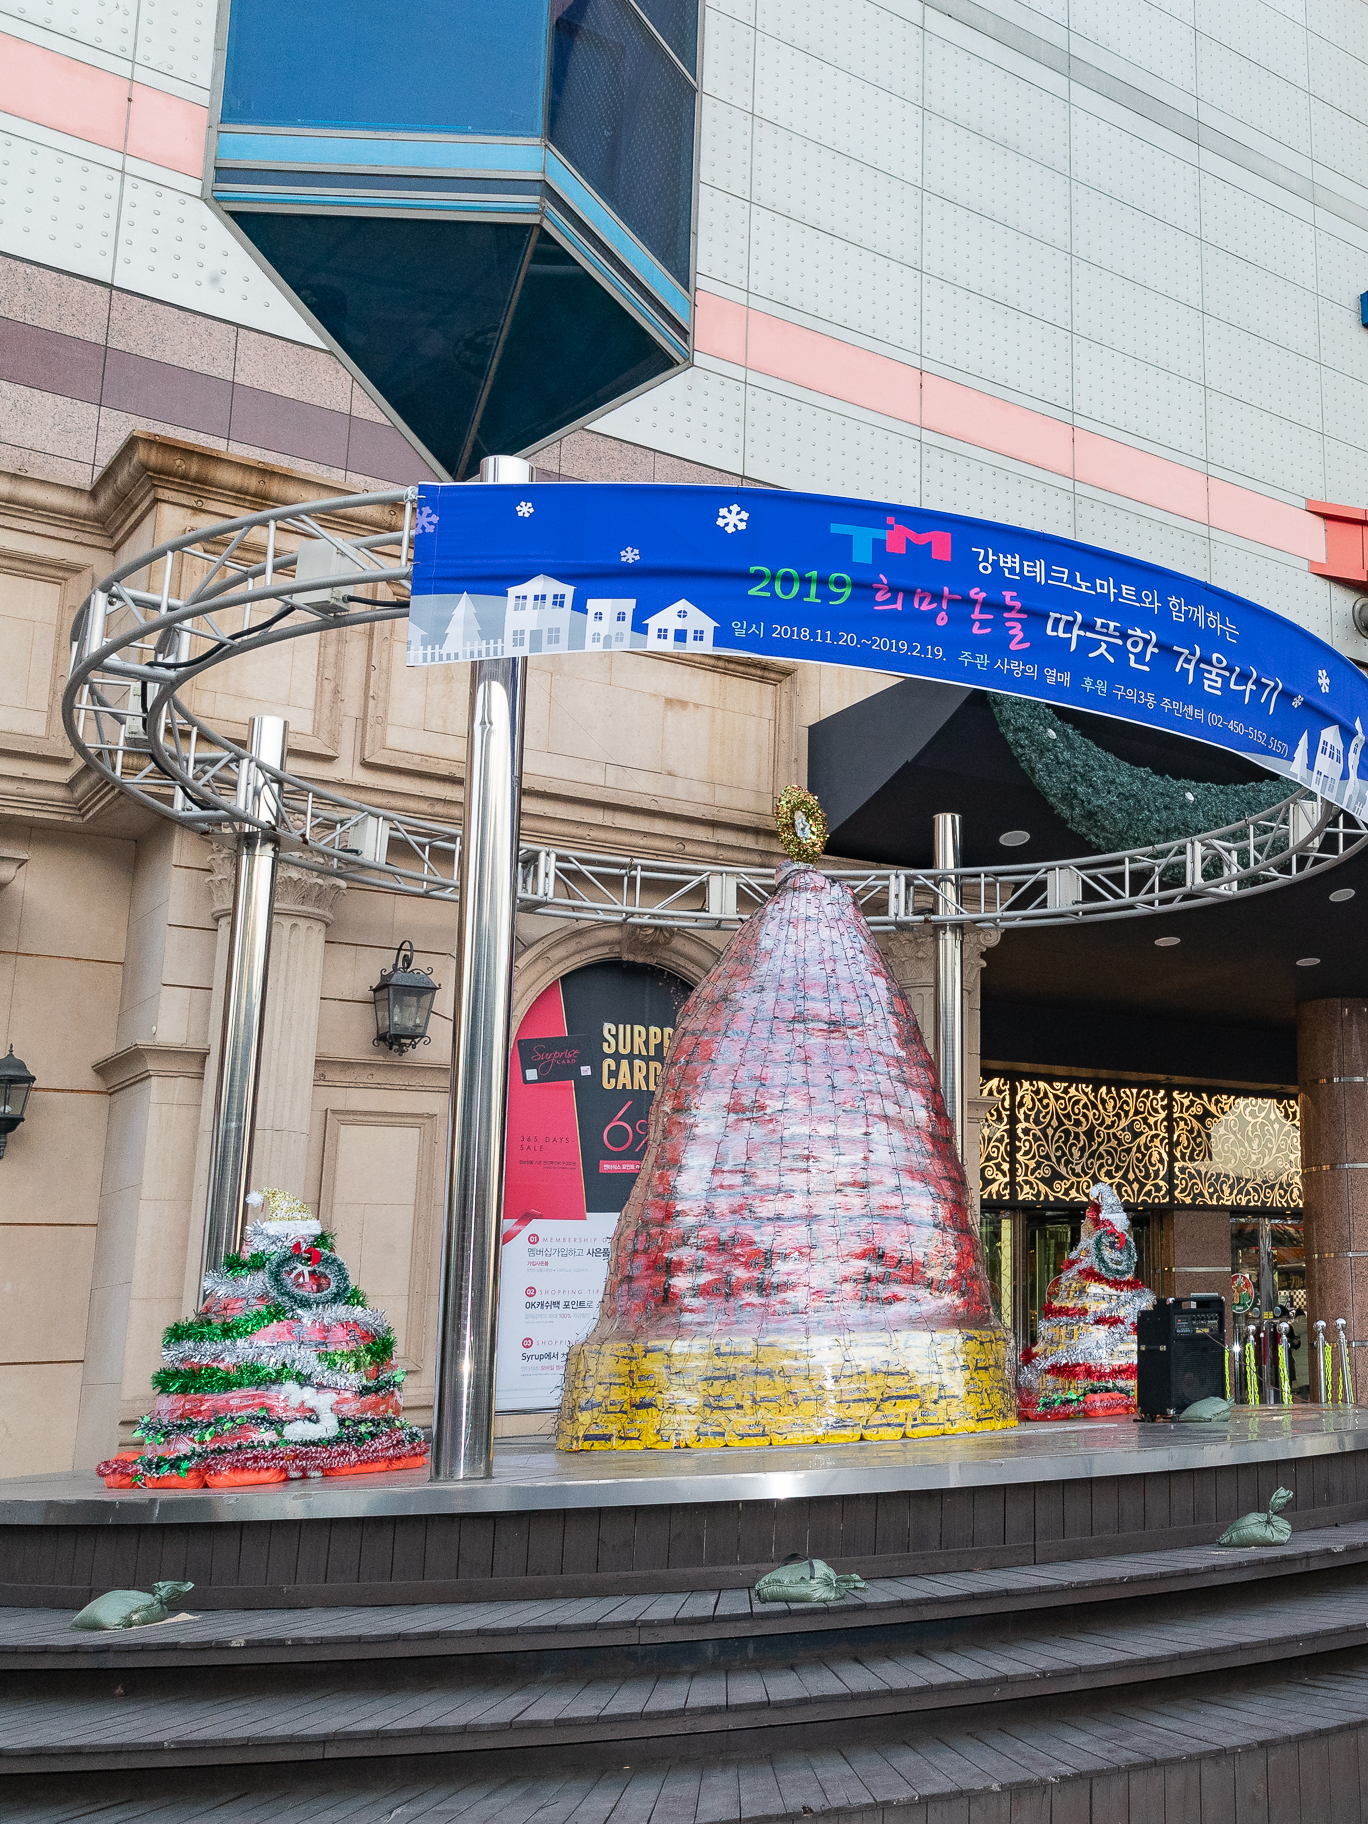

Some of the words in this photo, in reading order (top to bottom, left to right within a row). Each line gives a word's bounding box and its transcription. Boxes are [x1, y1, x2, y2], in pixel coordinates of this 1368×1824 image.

[972, 547, 1161, 614] 강변테크노마트와
[1167, 595, 1239, 643] 함께하는
[747, 566, 852, 605] 2019
[1046, 611, 1159, 671] 따뜻한
[1172, 644, 1283, 715] 겨울나기
[731, 620, 765, 639] 일시
[772, 624, 947, 661] 2018.11.20.~2019.2.19.
[958, 650, 990, 671] 주관
[994, 658, 1038, 680] 사랑의
[1044, 667, 1071, 687] 열매
[1081, 676, 1107, 697] 후원
[1112, 684, 1157, 710] 구의3동
[1160, 697, 1204, 724] 주민센터
[531, 1044, 580, 1076] Surprise
[520, 1135, 538, 1143] 365
[520, 1144, 544, 1152] SALE
[527, 1247, 584, 1258] 멤버십가입하고
[562, 1300, 594, 1309] 포인트로
[521, 1351, 559, 1362] Syrup에서
